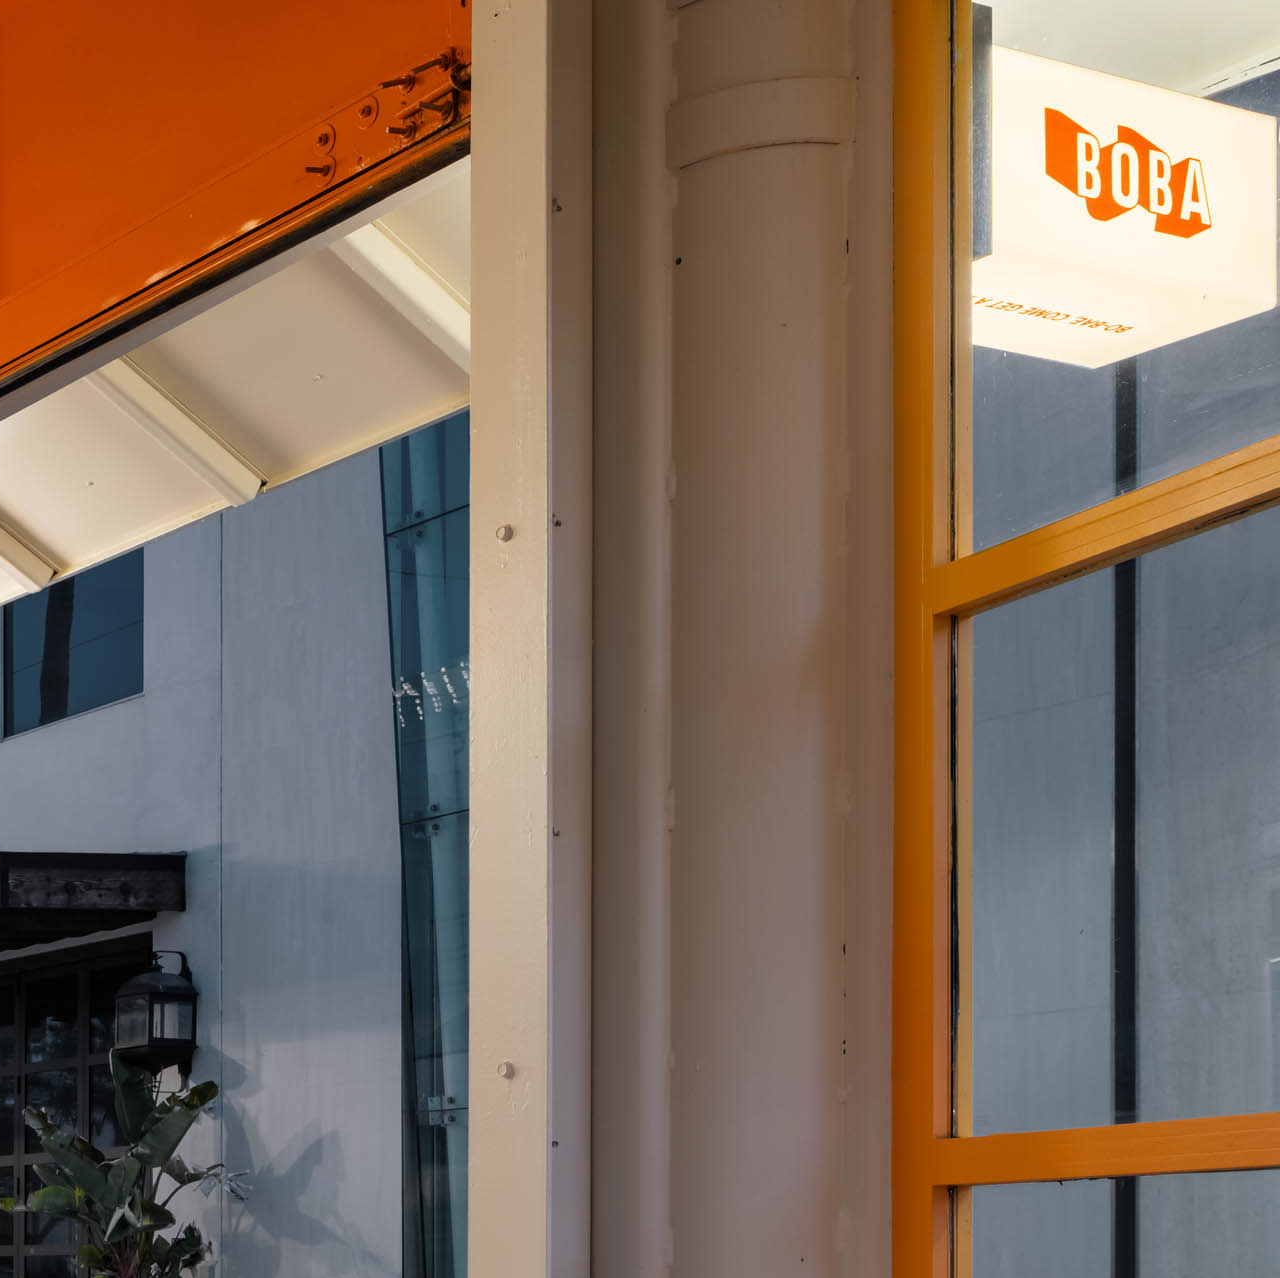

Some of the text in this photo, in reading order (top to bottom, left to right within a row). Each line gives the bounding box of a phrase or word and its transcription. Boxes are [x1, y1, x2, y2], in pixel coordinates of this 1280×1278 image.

[1075, 131, 1212, 227] BOBA
[984, 301, 1024, 312] GET
[1018, 306, 1071, 321] COME
